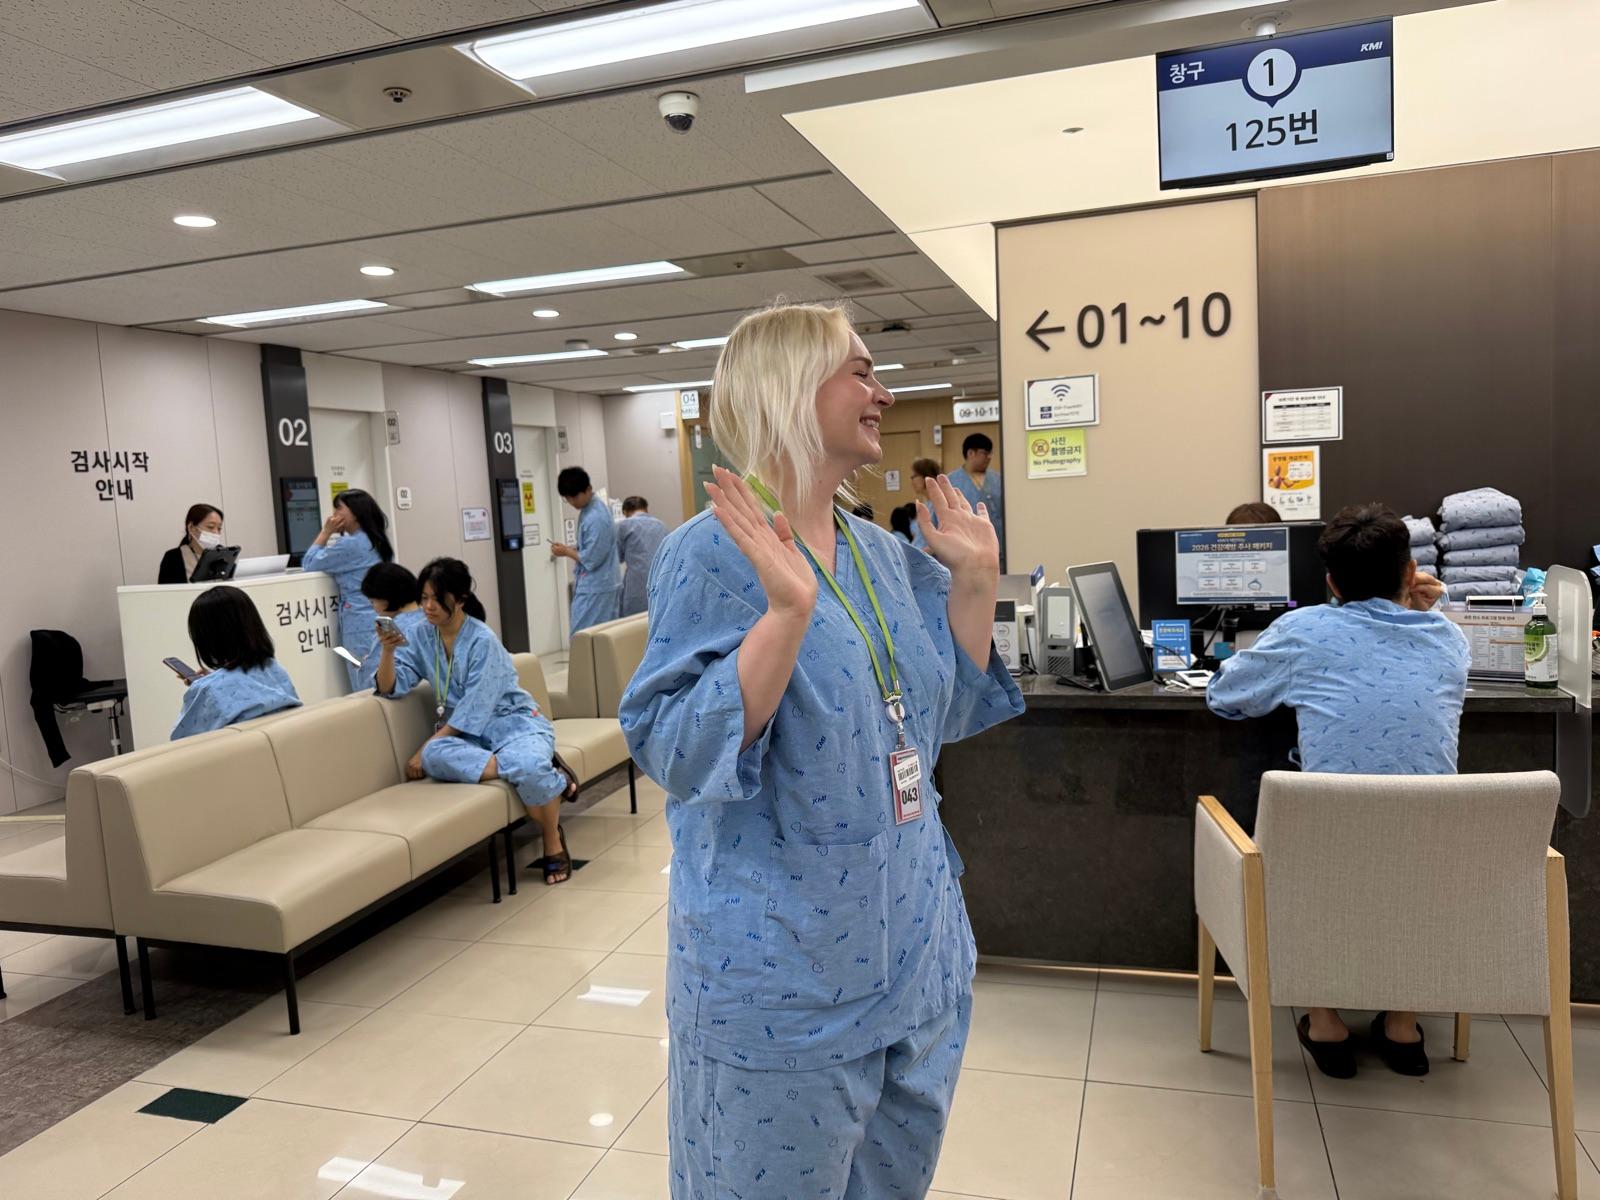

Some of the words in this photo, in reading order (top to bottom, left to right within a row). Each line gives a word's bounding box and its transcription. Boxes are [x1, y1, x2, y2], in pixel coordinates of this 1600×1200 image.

[1360, 41, 1383, 52] KMI
[1169, 61, 1205, 84] 창구
[1262, 58, 1274, 86] 1
[1225, 109, 1318, 151] 125번
[1077, 292, 1231, 348] 01~10
[683, 393, 695, 404] 04
[278, 417, 308, 446] 02
[1050, 436, 1066, 446] 사진
[494, 432, 513, 454] 03
[1051, 446, 1081, 456] 촬영금지
[71, 450, 149, 473] 검사시작
[1043, 457, 1081, 466] Photography
[96, 479, 134, 501] 안내
[298, 625, 331, 653] 안내
[816, 736, 826, 751] KMI
[901, 787, 918, 805] 043
[725, 897, 740, 905] KMI
[781, 992, 798, 1001] KMI
